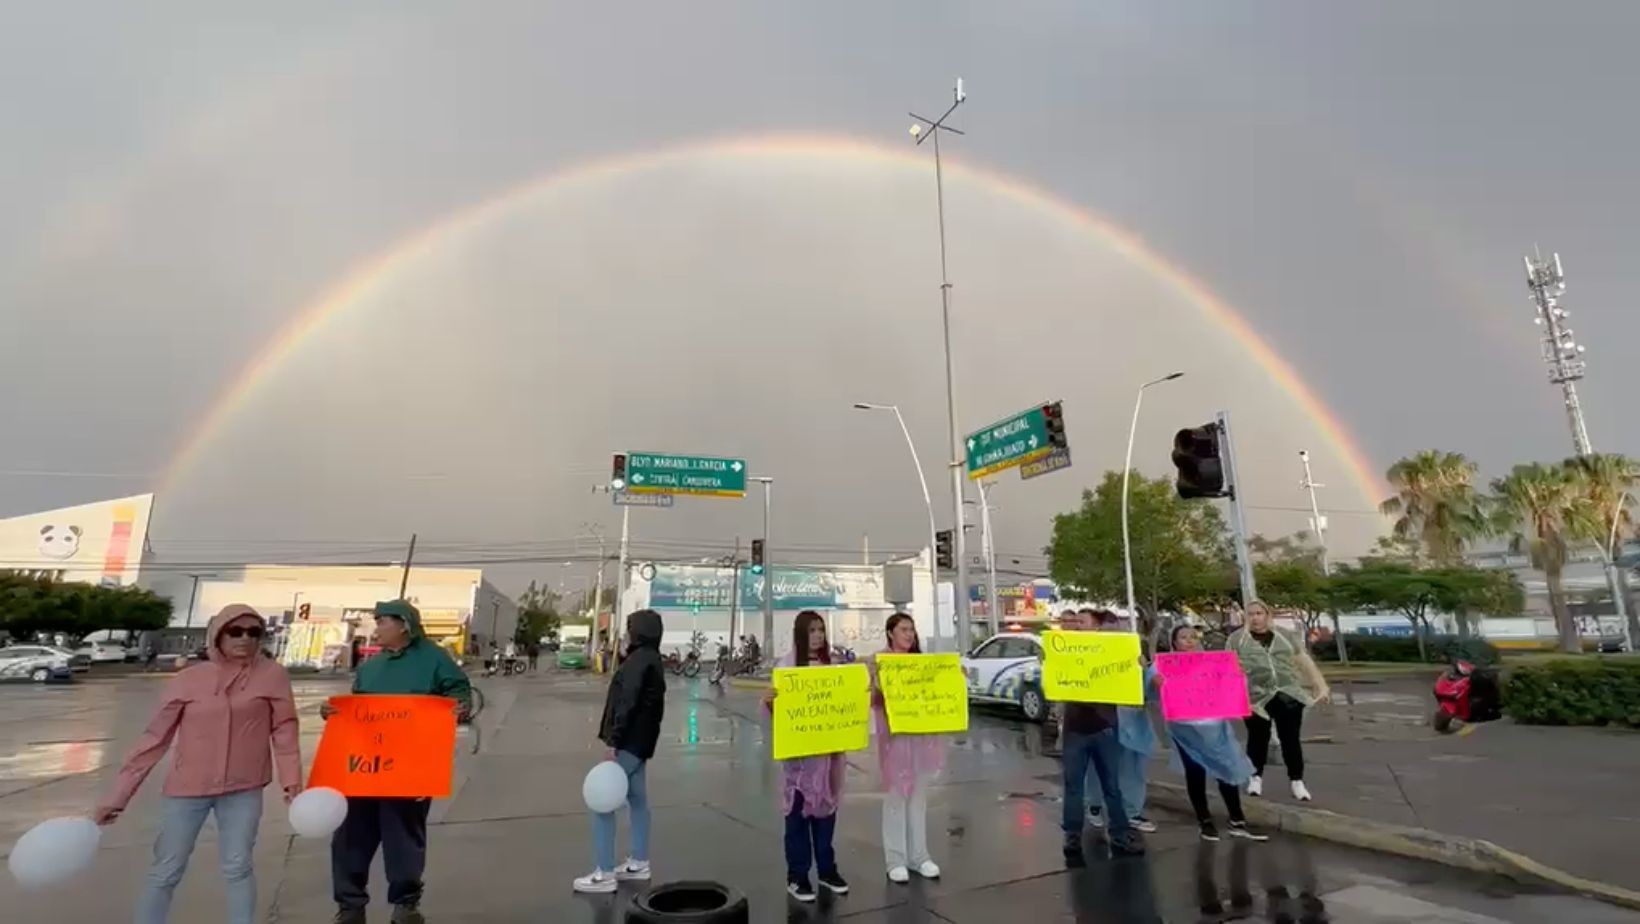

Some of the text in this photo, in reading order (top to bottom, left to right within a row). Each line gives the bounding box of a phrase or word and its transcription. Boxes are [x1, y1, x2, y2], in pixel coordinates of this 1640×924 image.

[784, 673, 844, 693] JUSTICIA
[807, 690, 832, 702] PARA
[348, 754, 394, 774] Vale
